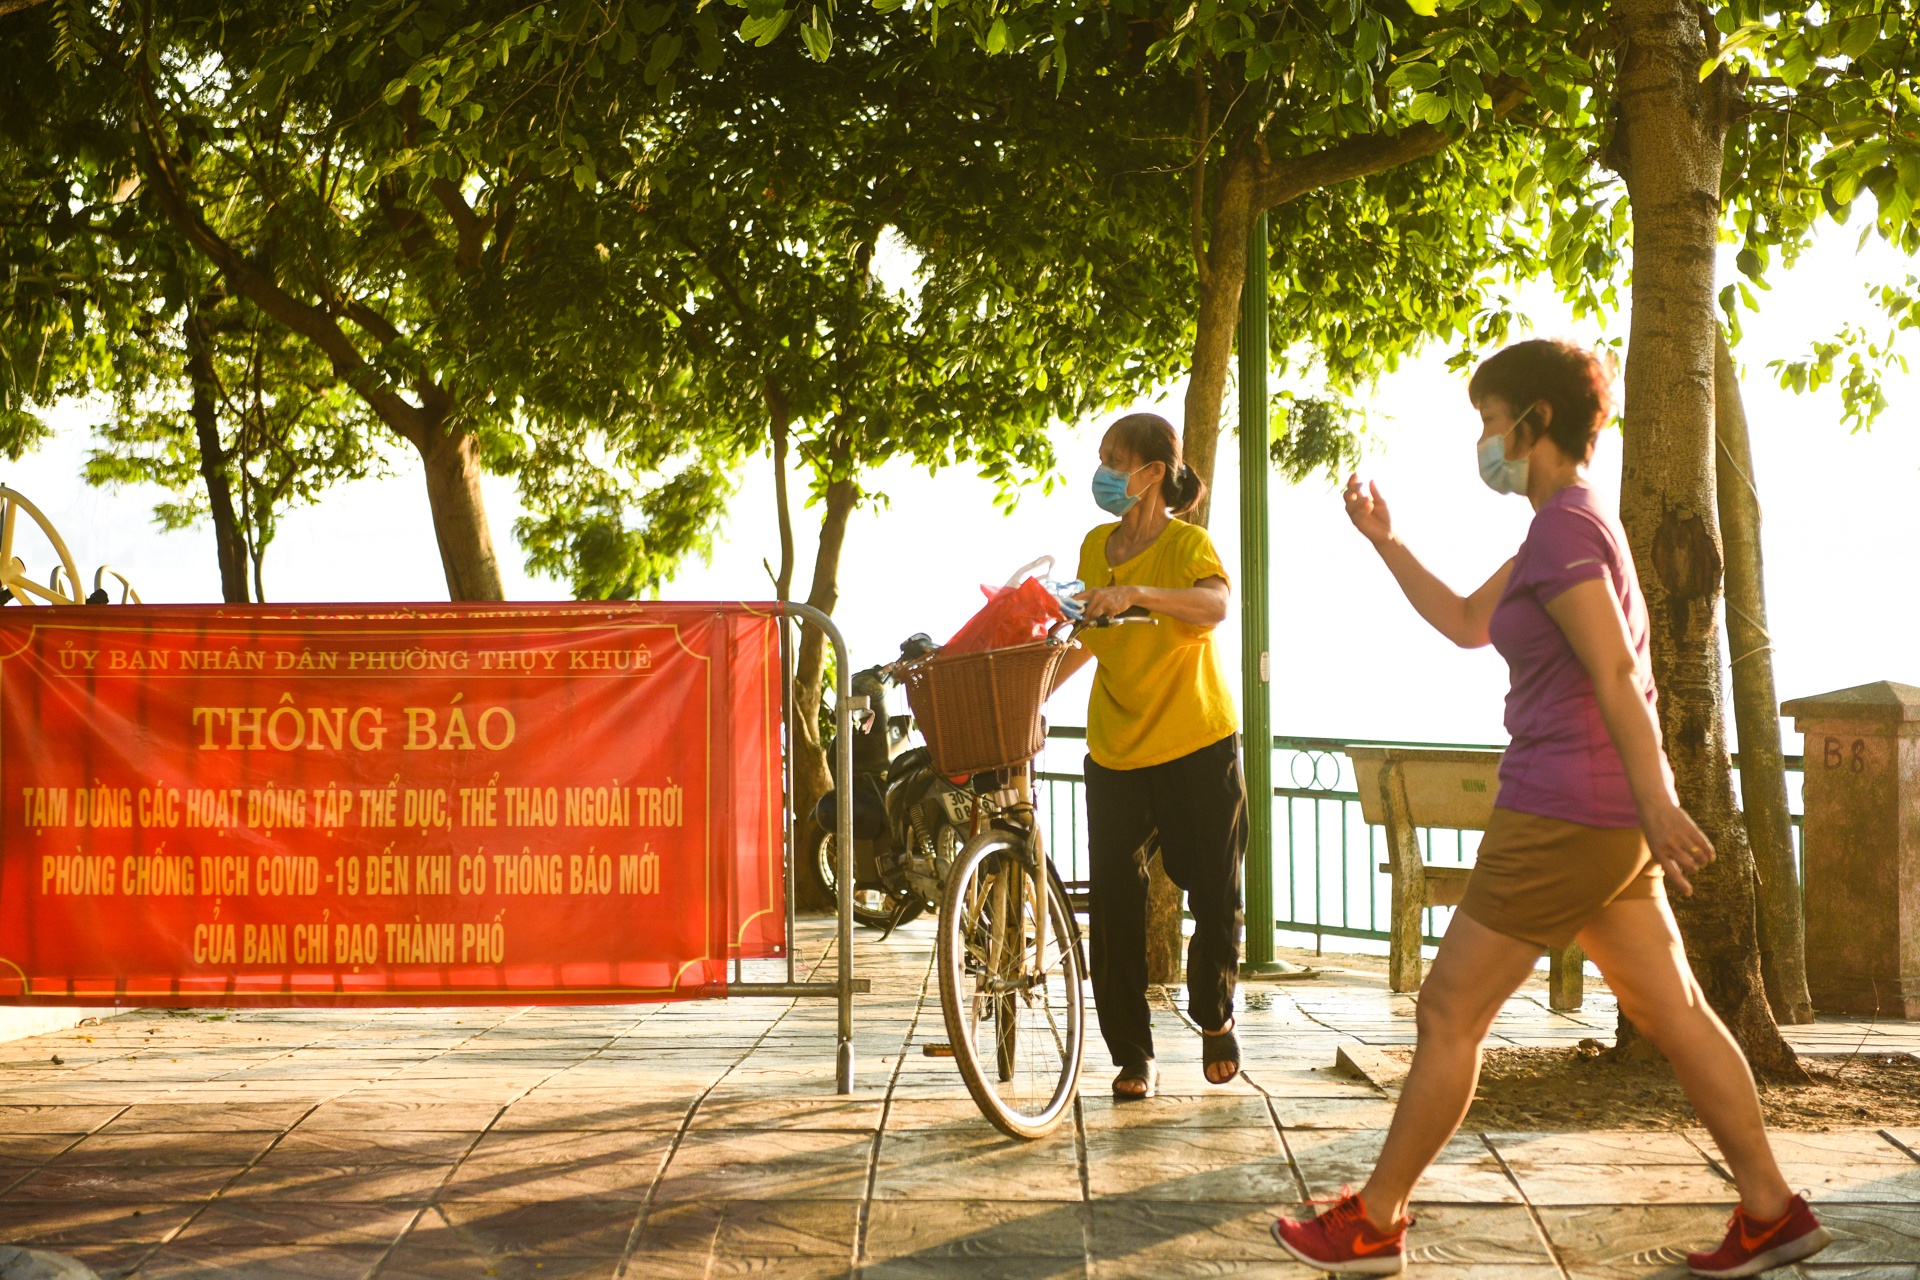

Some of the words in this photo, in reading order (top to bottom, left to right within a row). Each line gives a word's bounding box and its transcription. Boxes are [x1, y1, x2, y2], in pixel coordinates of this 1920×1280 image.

[59, 641, 100, 670] ỦY
[109, 650, 171, 670] BAN
[179, 646, 265, 670] NHÂN
[275, 647, 339, 670] DÂN
[348, 646, 471, 670] PHƯỜNG
[478, 650, 559, 676] THỤY
[569, 643, 651, 670] KHUÊ
[193, 692, 387, 752] THÔNG
[404, 692, 516, 751] BÁO
[23, 787, 67, 836] TẠM
[75, 778, 132, 828] DỪNG
[139, 780, 179, 828] CÁC
[187, 789, 242, 837] HOẠT
[248, 781, 306, 838] ĐỘNG
[314, 781, 353, 838] TẬP
[360, 774, 400, 828] THỂ
[405, 787, 452, 836] DỤC,
[460, 772, 500, 827] THỂ
[505, 787, 558, 827] THAO
[566, 779, 630, 827] NGOÀI
[637, 777, 683, 827] TRỜI
[42, 846, 115, 895] PHÒNG
[123, 842, 194, 896] CHỐNG
[202, 856, 249, 905] DỊCH
[257, 856, 319, 896] COVID
[367, 842, 409, 895] ĐẾN
[417, 855, 451, 895] KHI
[459, 846, 486, 896] CÓ
[494, 847, 563, 895] THÔNG
[571, 847, 612, 895] BÁO
[620, 843, 660, 895] MỚI
[194, 907, 236, 964] CỦA
[244, 924, 287, 964] BAN
[295, 909, 330, 964] CHỈ
[336, 924, 378, 973] ĐẠO
[385, 916, 455, 963] THÀNH
[463, 909, 505, 964] PHỐ
